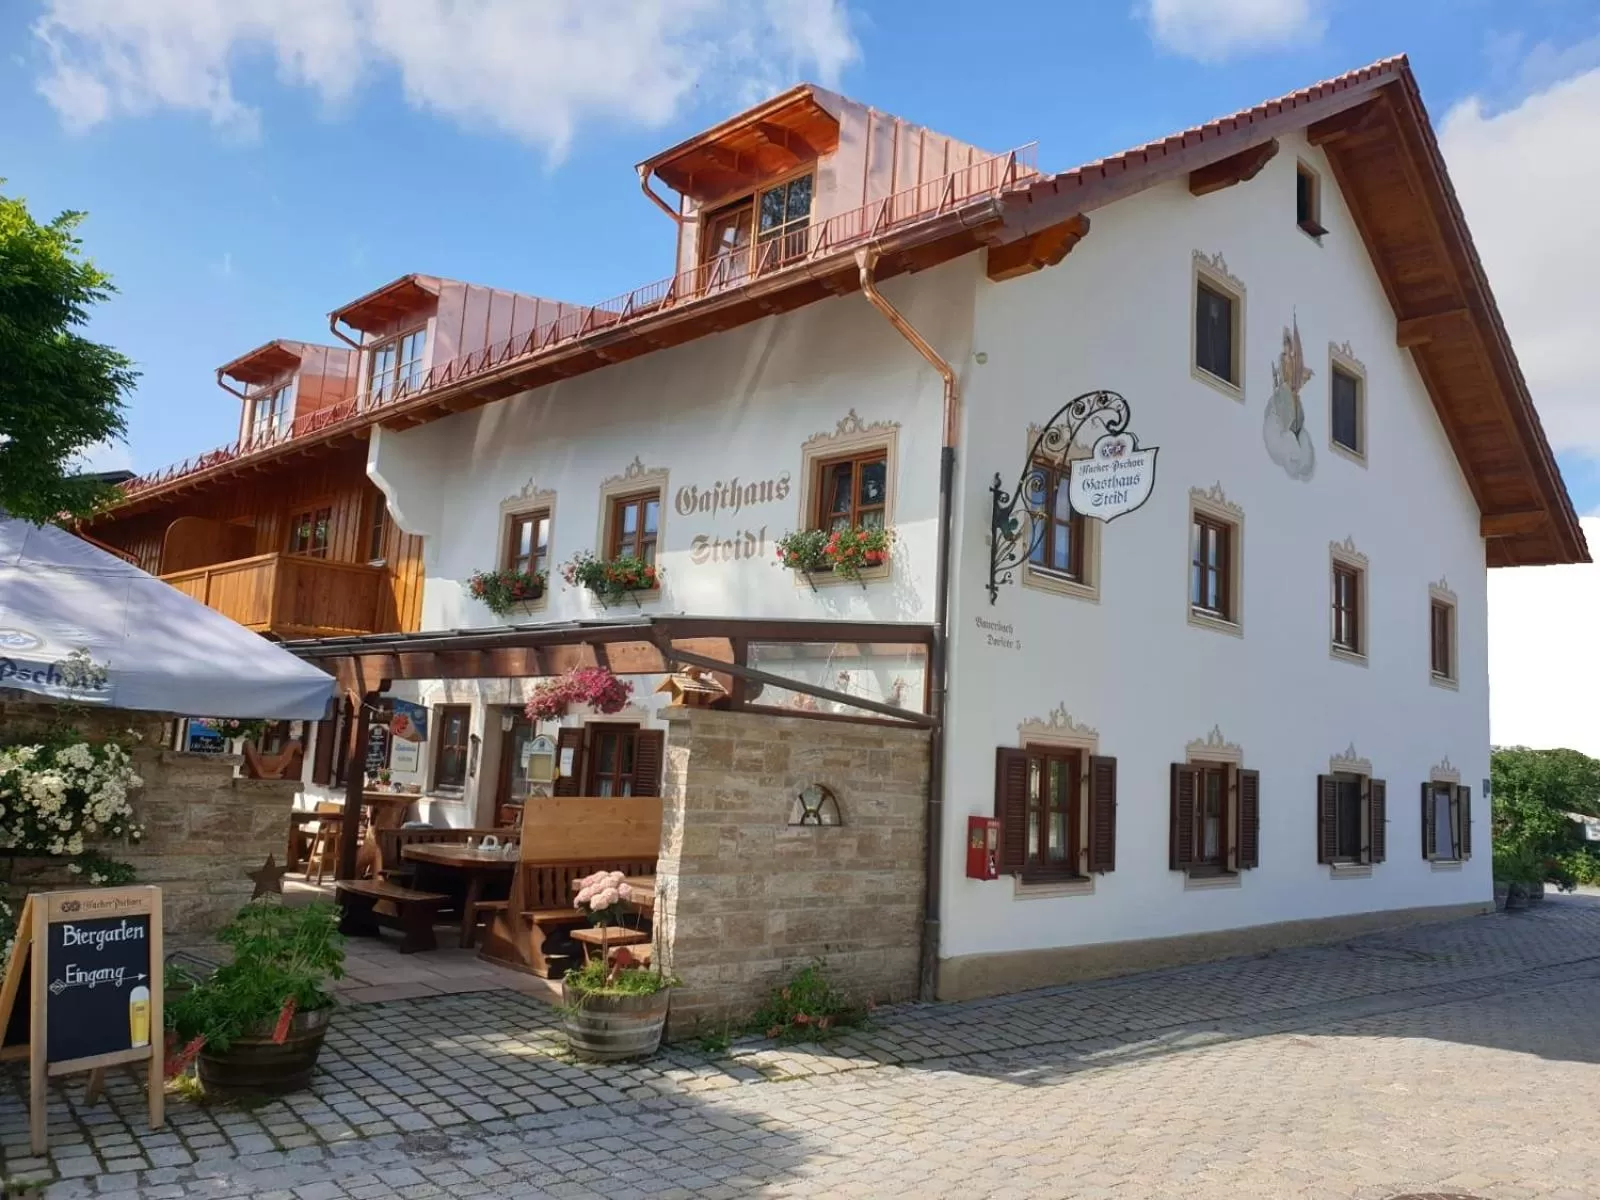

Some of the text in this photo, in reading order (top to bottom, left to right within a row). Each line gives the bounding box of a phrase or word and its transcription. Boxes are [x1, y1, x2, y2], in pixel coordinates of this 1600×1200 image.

[1082, 474, 1141, 492] Gasthaus
[1091, 490, 1128, 507] Steidl
[690, 525, 768, 565] Steidl
[0, 657, 108, 690] Psch
[63, 920, 145, 951] Biergarten
[65, 964, 125, 988] Eingang
